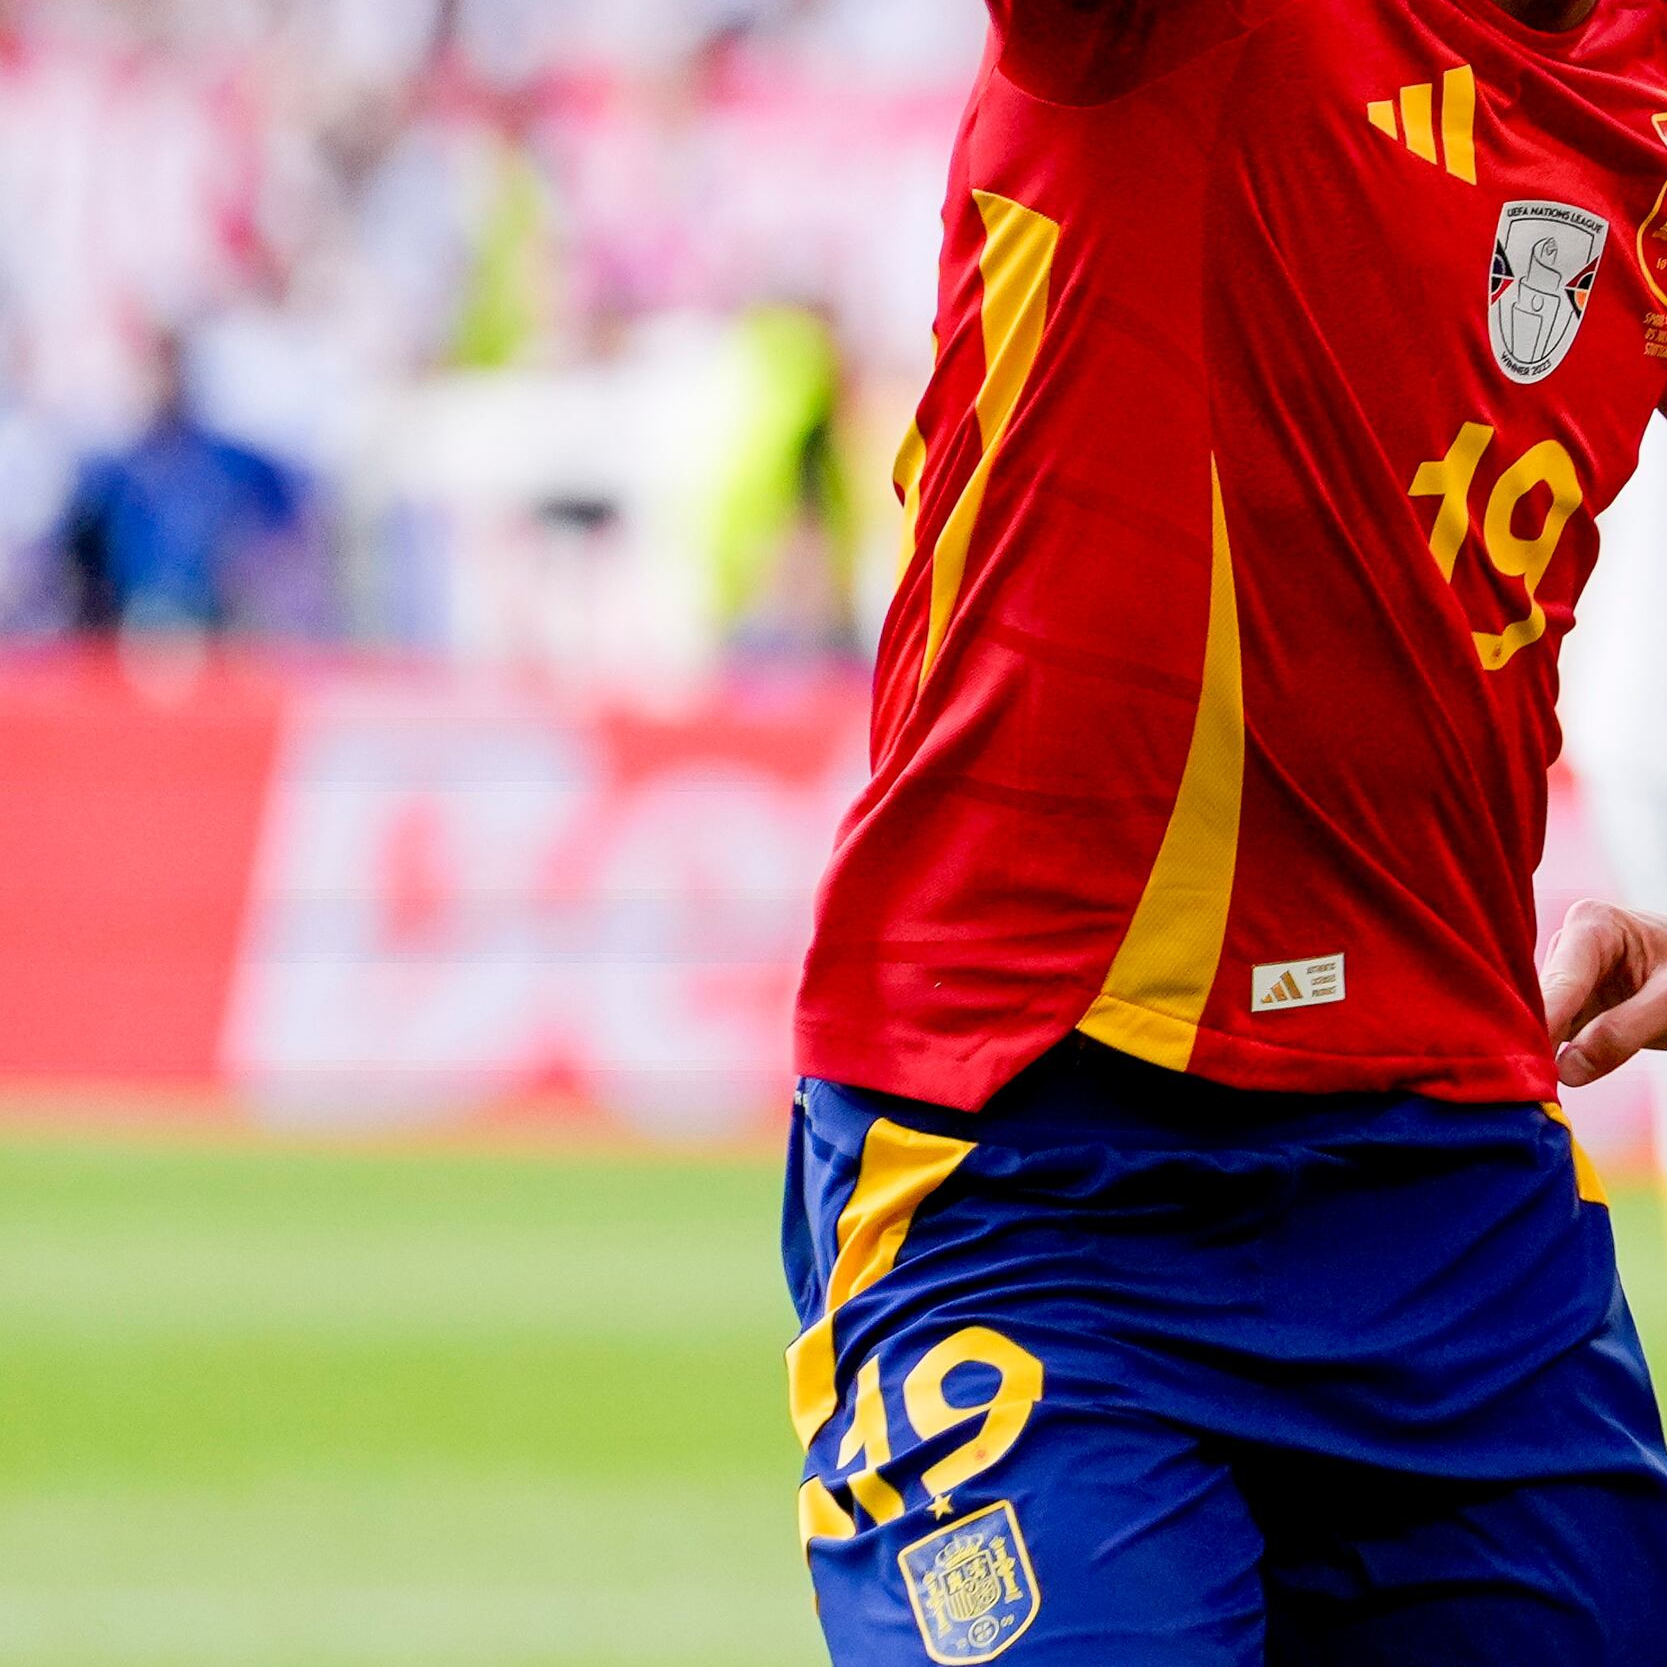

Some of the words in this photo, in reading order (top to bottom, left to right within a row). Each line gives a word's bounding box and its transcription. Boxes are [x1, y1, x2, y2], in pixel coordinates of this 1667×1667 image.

[1507, 207, 1528, 217] UEFA
[1531, 207, 1569, 220] NATIONS
[1571, 213, 1604, 233] LEAGUE
[1501, 351, 1529, 376] WINNER
[1531, 361, 1552, 376] 2023
[1408, 421, 1583, 671] 19
[836, 1326, 1044, 1526] 19
